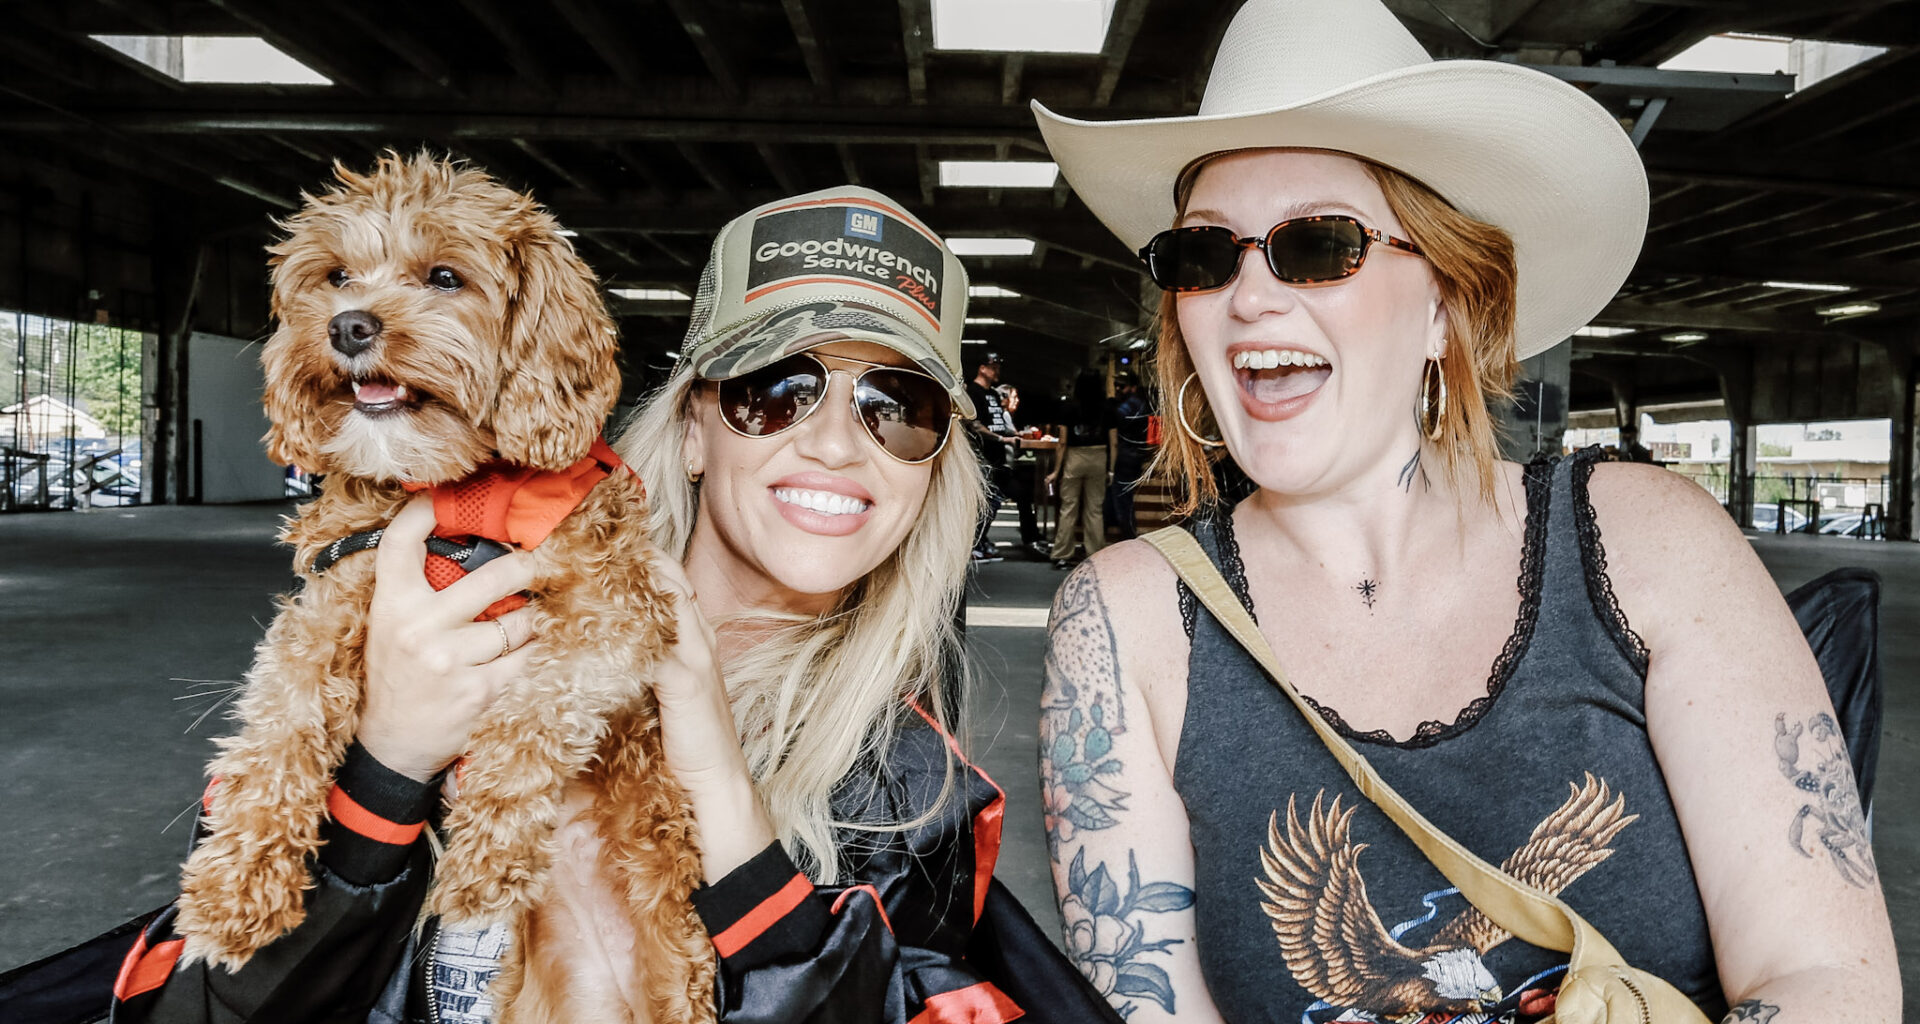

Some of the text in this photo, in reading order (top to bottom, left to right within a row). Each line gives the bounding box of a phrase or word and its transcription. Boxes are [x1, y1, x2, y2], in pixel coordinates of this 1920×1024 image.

[851, 212, 878, 233] GM
[755, 238, 938, 293] Goodwrench
[803, 254, 936, 310] Service Plus
